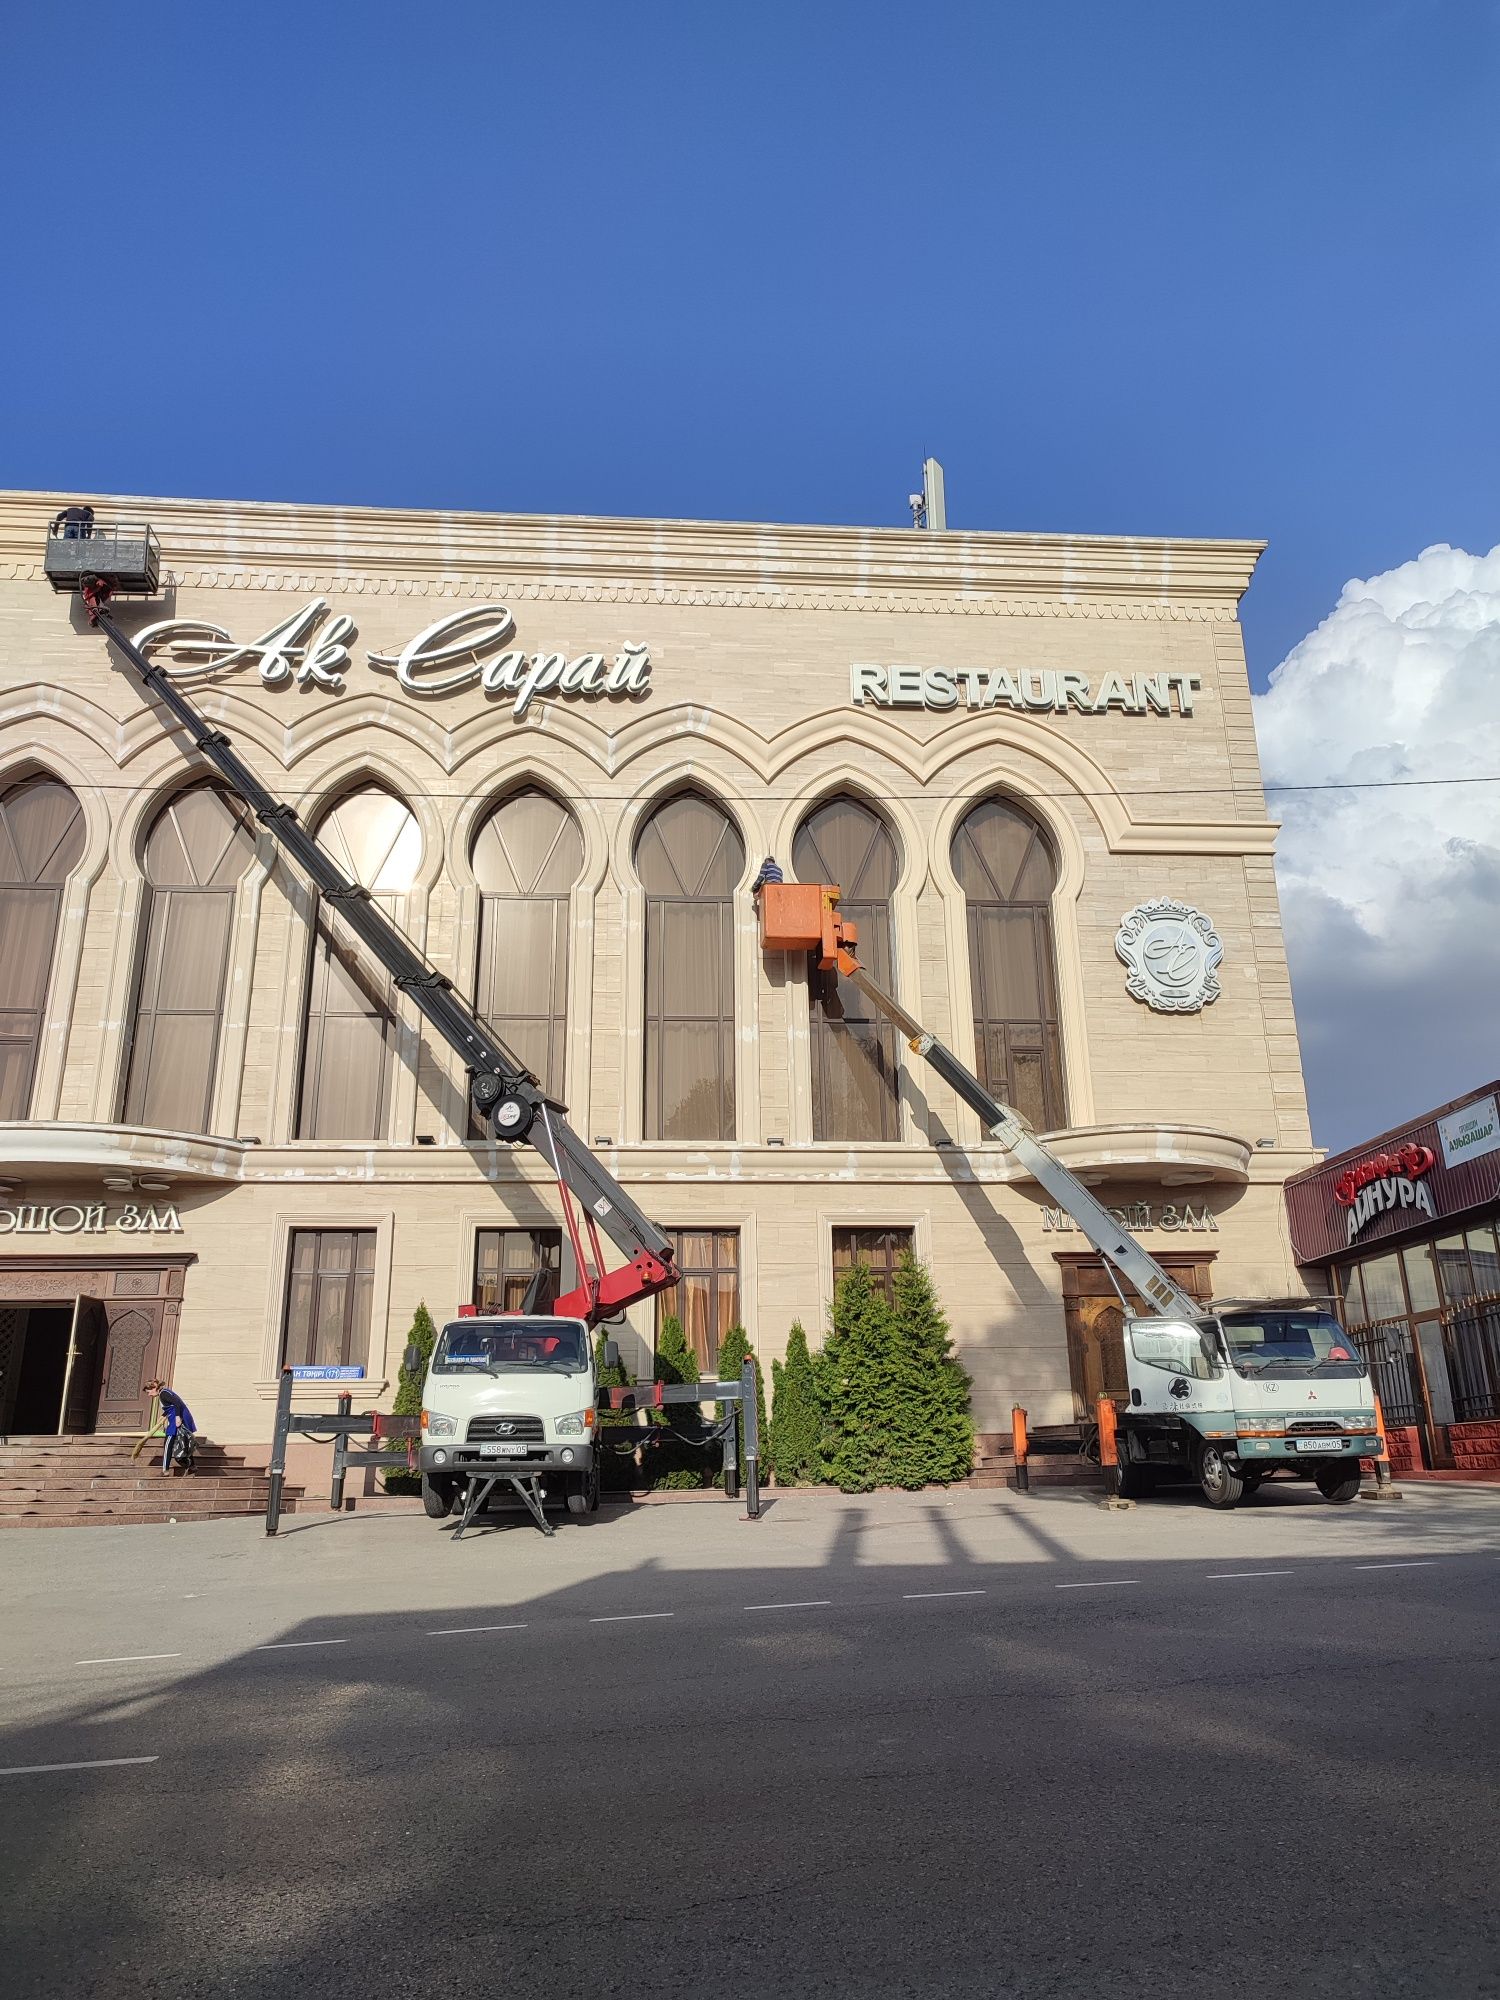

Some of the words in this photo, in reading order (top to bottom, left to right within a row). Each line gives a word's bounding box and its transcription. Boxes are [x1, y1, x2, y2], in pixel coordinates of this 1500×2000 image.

[366, 604, 650, 715] Сарай
[849, 664, 1201, 713] RESTAURANT
[1449, 1124, 1493, 1152] АУЫЗАШАР
[1347, 1177, 1433, 1246] АЙНУРА
